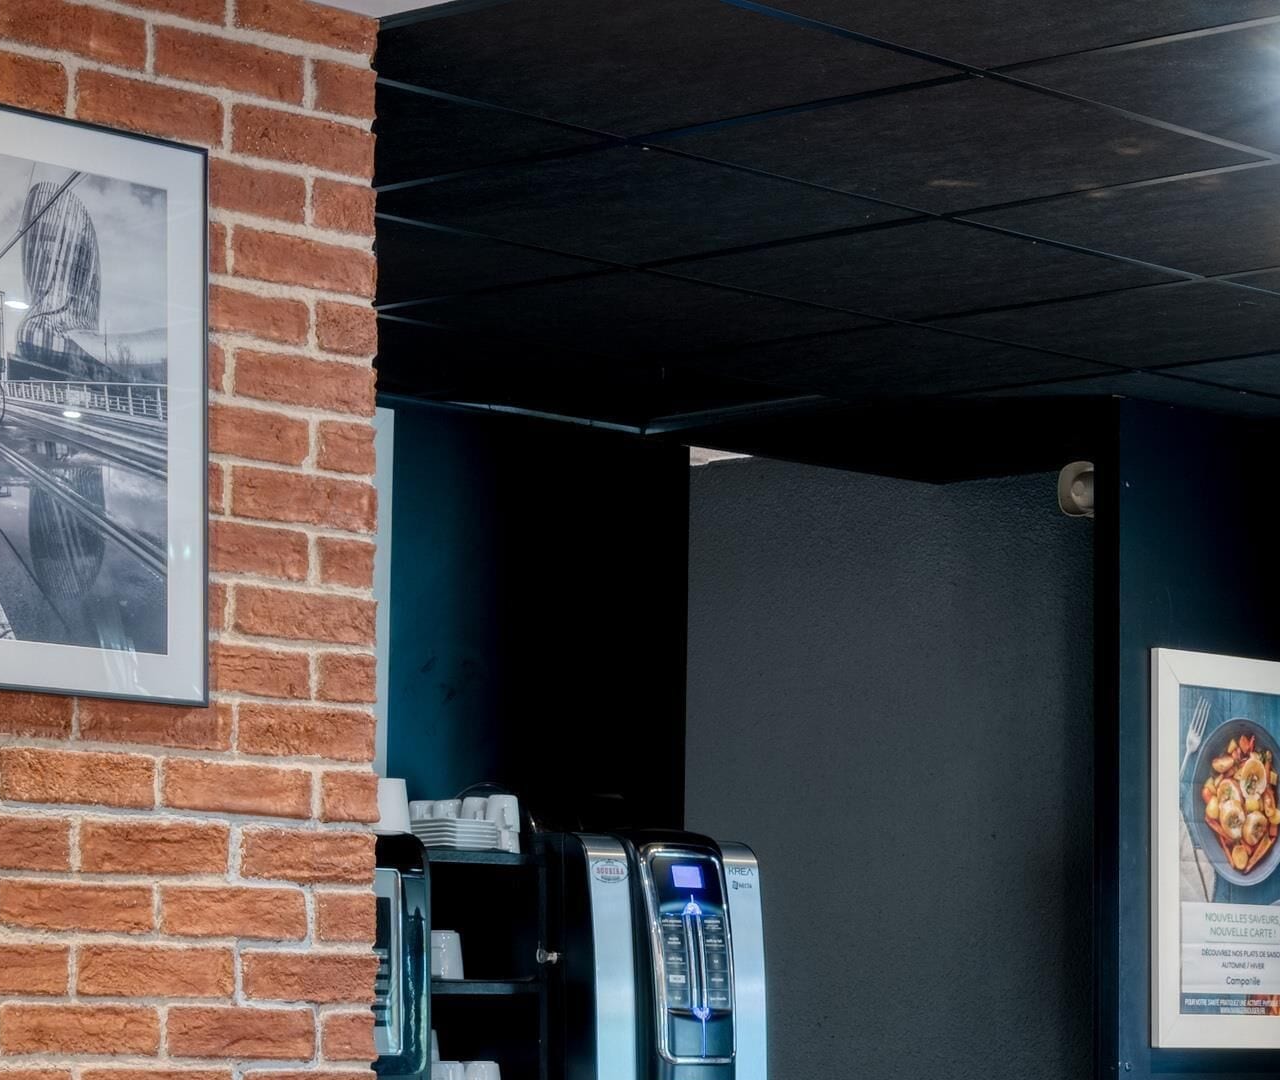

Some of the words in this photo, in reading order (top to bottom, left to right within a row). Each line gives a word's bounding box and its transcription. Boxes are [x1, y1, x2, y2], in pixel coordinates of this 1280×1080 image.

[1205, 912, 1247, 923] NOUVELLES
[1210, 926, 1248, 937] NOUVELLE
[1249, 928, 1273, 938] CARTE
[1232, 949, 1243, 957] NOS
[1244, 949, 1260, 958] PLATS
[1260, 950, 1266, 958] DE
[1250, 962, 1265, 970] HIVER
[1226, 976, 1260, 987] Campanile
